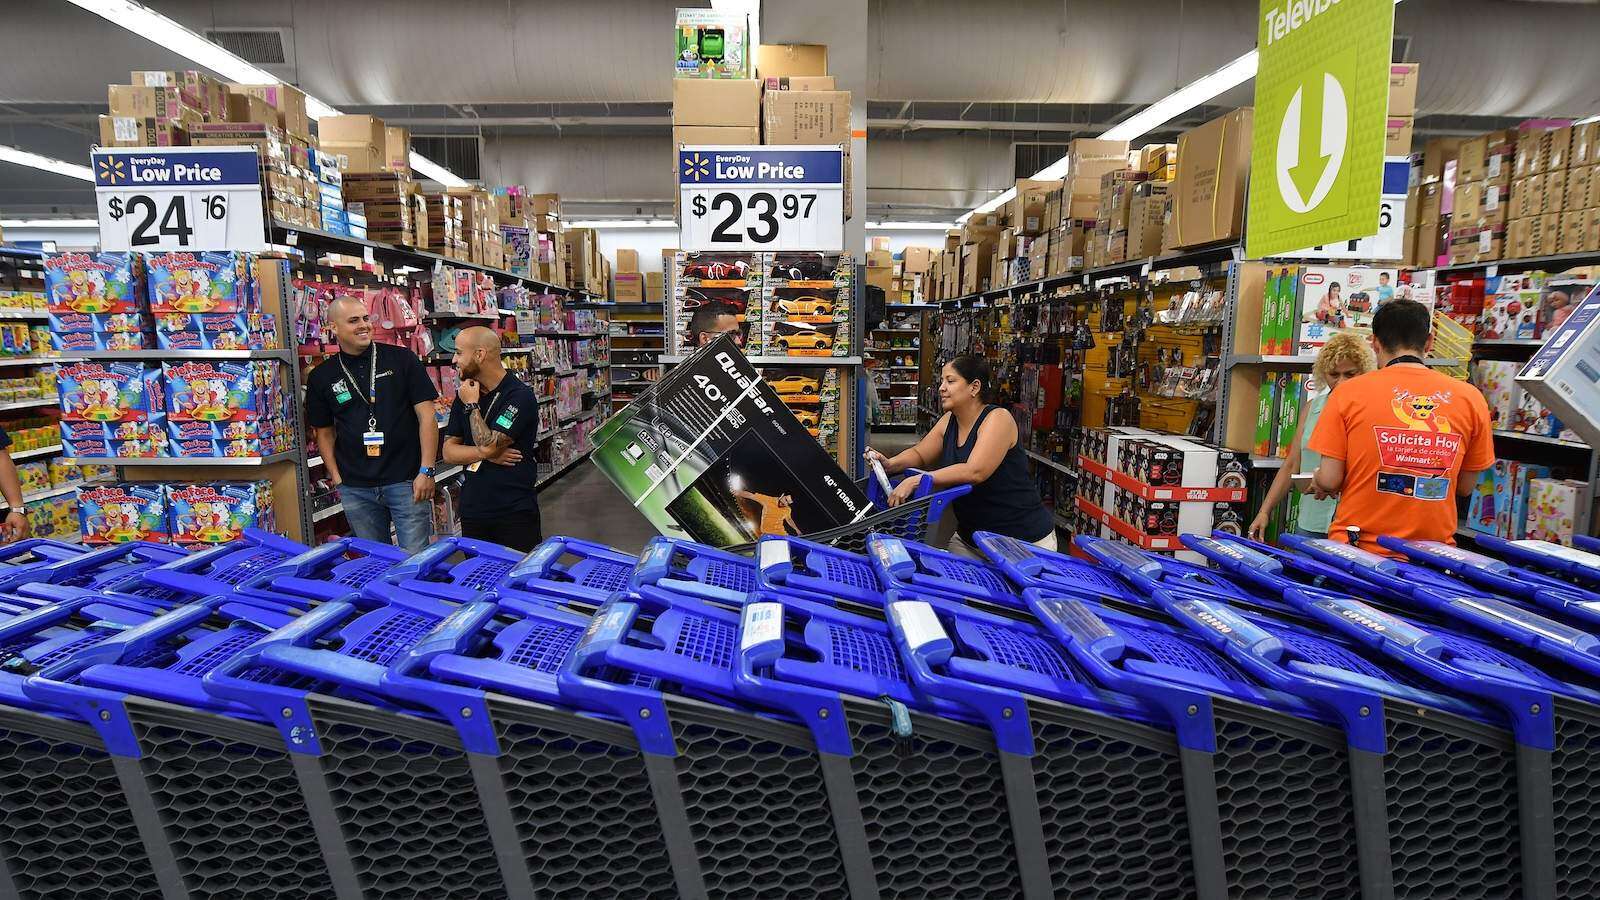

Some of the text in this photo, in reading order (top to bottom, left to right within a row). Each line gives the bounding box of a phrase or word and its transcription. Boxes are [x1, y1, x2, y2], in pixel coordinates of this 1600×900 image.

[130, 157, 166, 165] EveryDay
[715, 155, 751, 164] EveryDay
[130, 163, 222, 182] Low Price
[715, 162, 805, 179] Low Price
[714, 351, 775, 415] Quasar
[1380, 431, 1459, 452] Solicita Hoy
[1394, 445, 1418, 454] tarjeta
[1395, 454, 1431, 464] Walmart
[836, 487, 856, 512] 1080p
